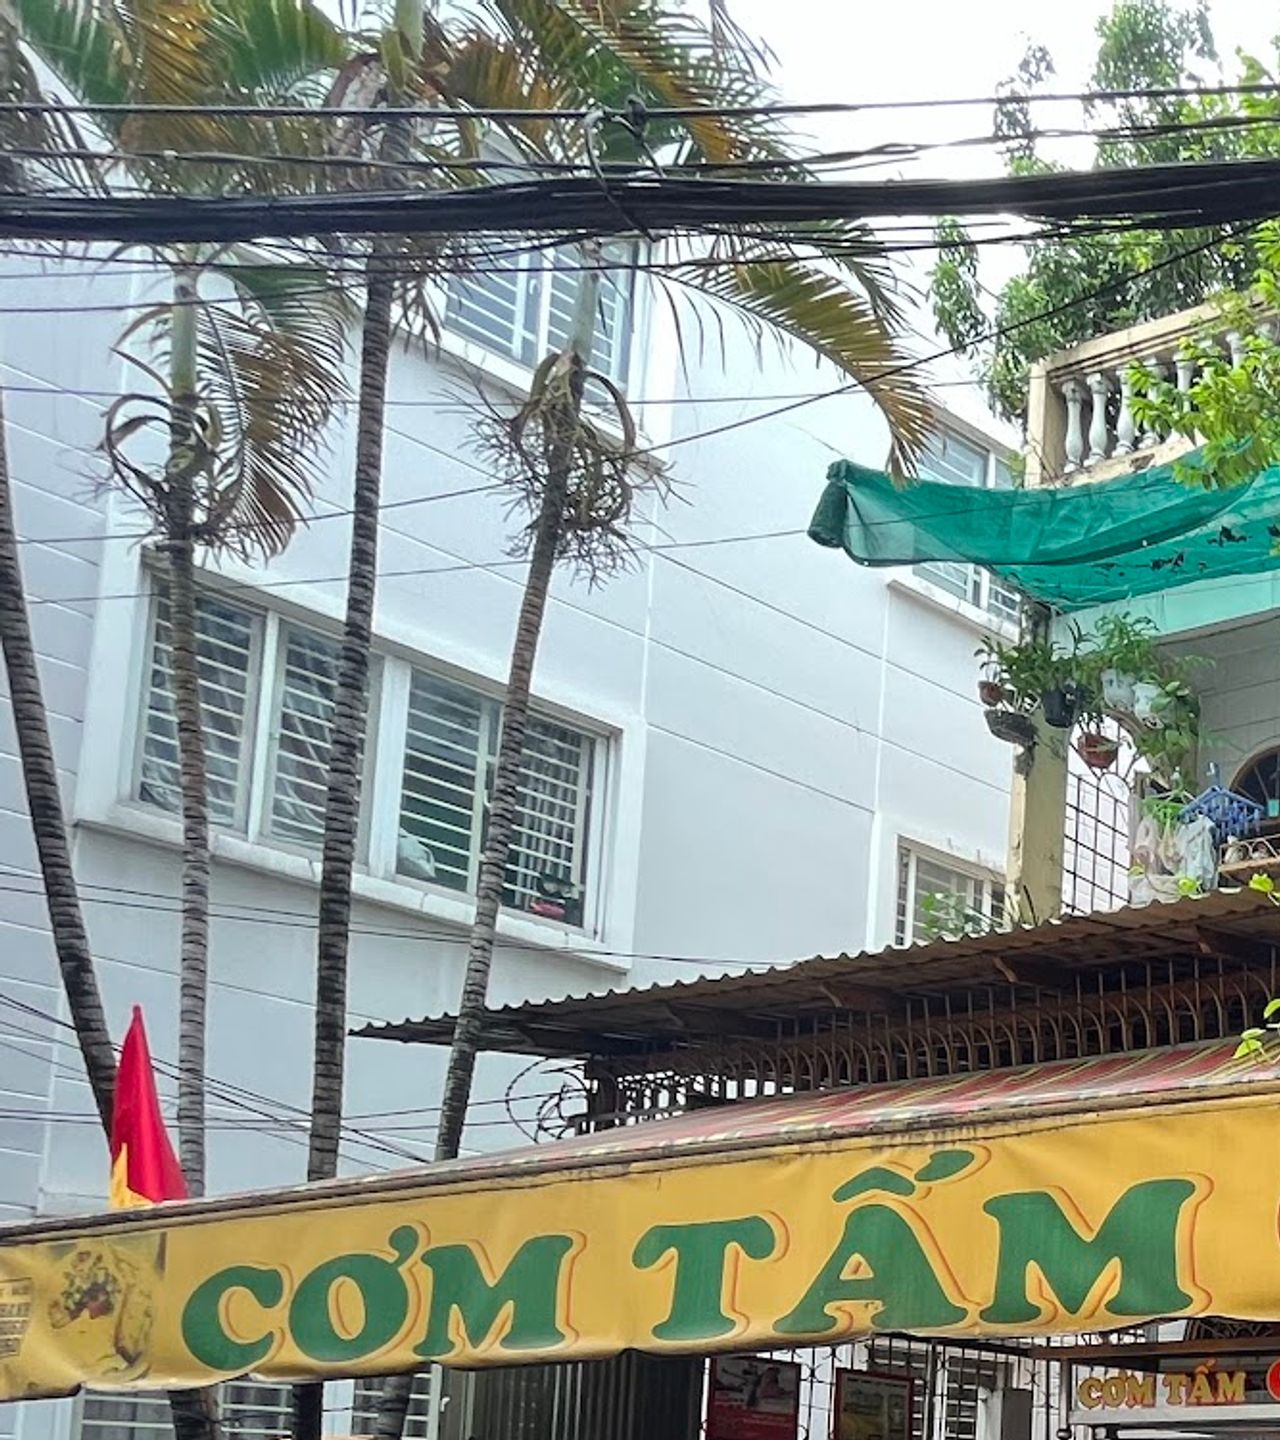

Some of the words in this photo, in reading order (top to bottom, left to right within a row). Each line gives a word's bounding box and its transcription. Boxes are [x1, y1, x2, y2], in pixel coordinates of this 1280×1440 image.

[182, 1222, 580, 1372] CƠM
[631, 1146, 1208, 1342] TẤM
[1078, 1368, 1156, 1411] CƠM
[1162, 1357, 1248, 1407] TẤM
